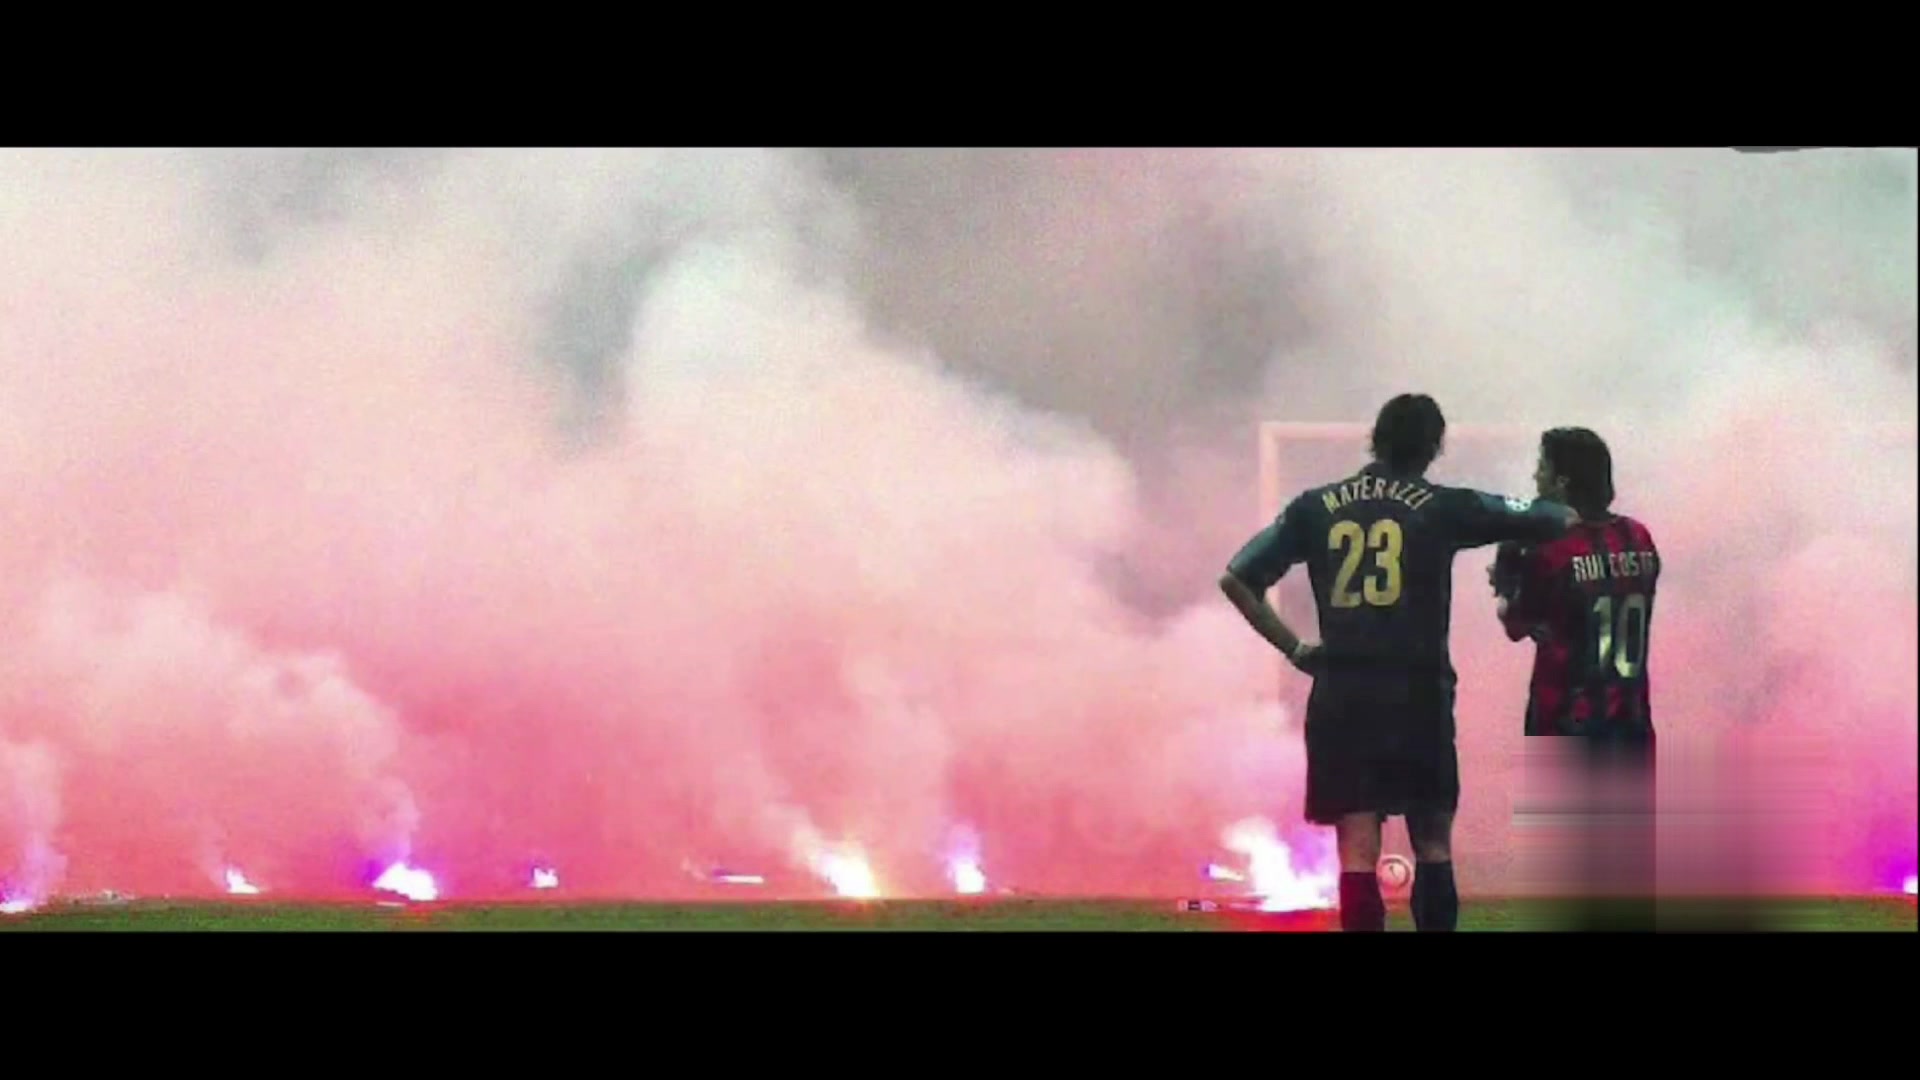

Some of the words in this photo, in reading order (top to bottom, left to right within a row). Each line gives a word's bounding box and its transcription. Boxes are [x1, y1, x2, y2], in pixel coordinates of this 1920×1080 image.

[1322, 475, 1433, 514] MATERAZZI
[1328, 519, 1403, 608] 23
[1572, 554, 1606, 582] RUI
[1593, 593, 1646, 678] 10
